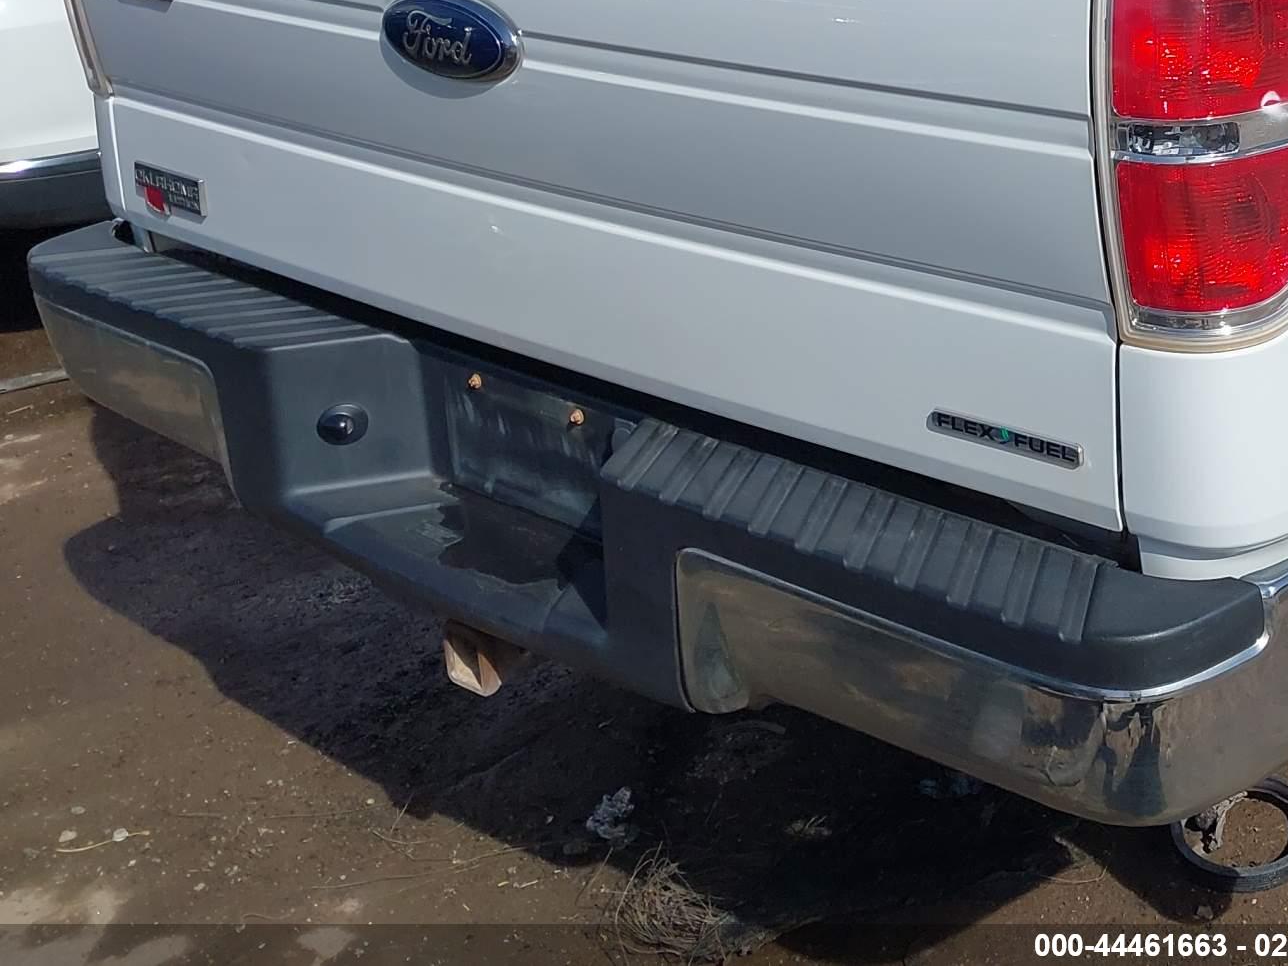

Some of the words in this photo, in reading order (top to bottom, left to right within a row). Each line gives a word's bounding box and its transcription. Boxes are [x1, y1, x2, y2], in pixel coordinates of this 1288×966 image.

[402, 9, 472, 65] Ford
[936, 412, 995, 442] FLEX
[1014, 433, 1076, 463] FUEL
